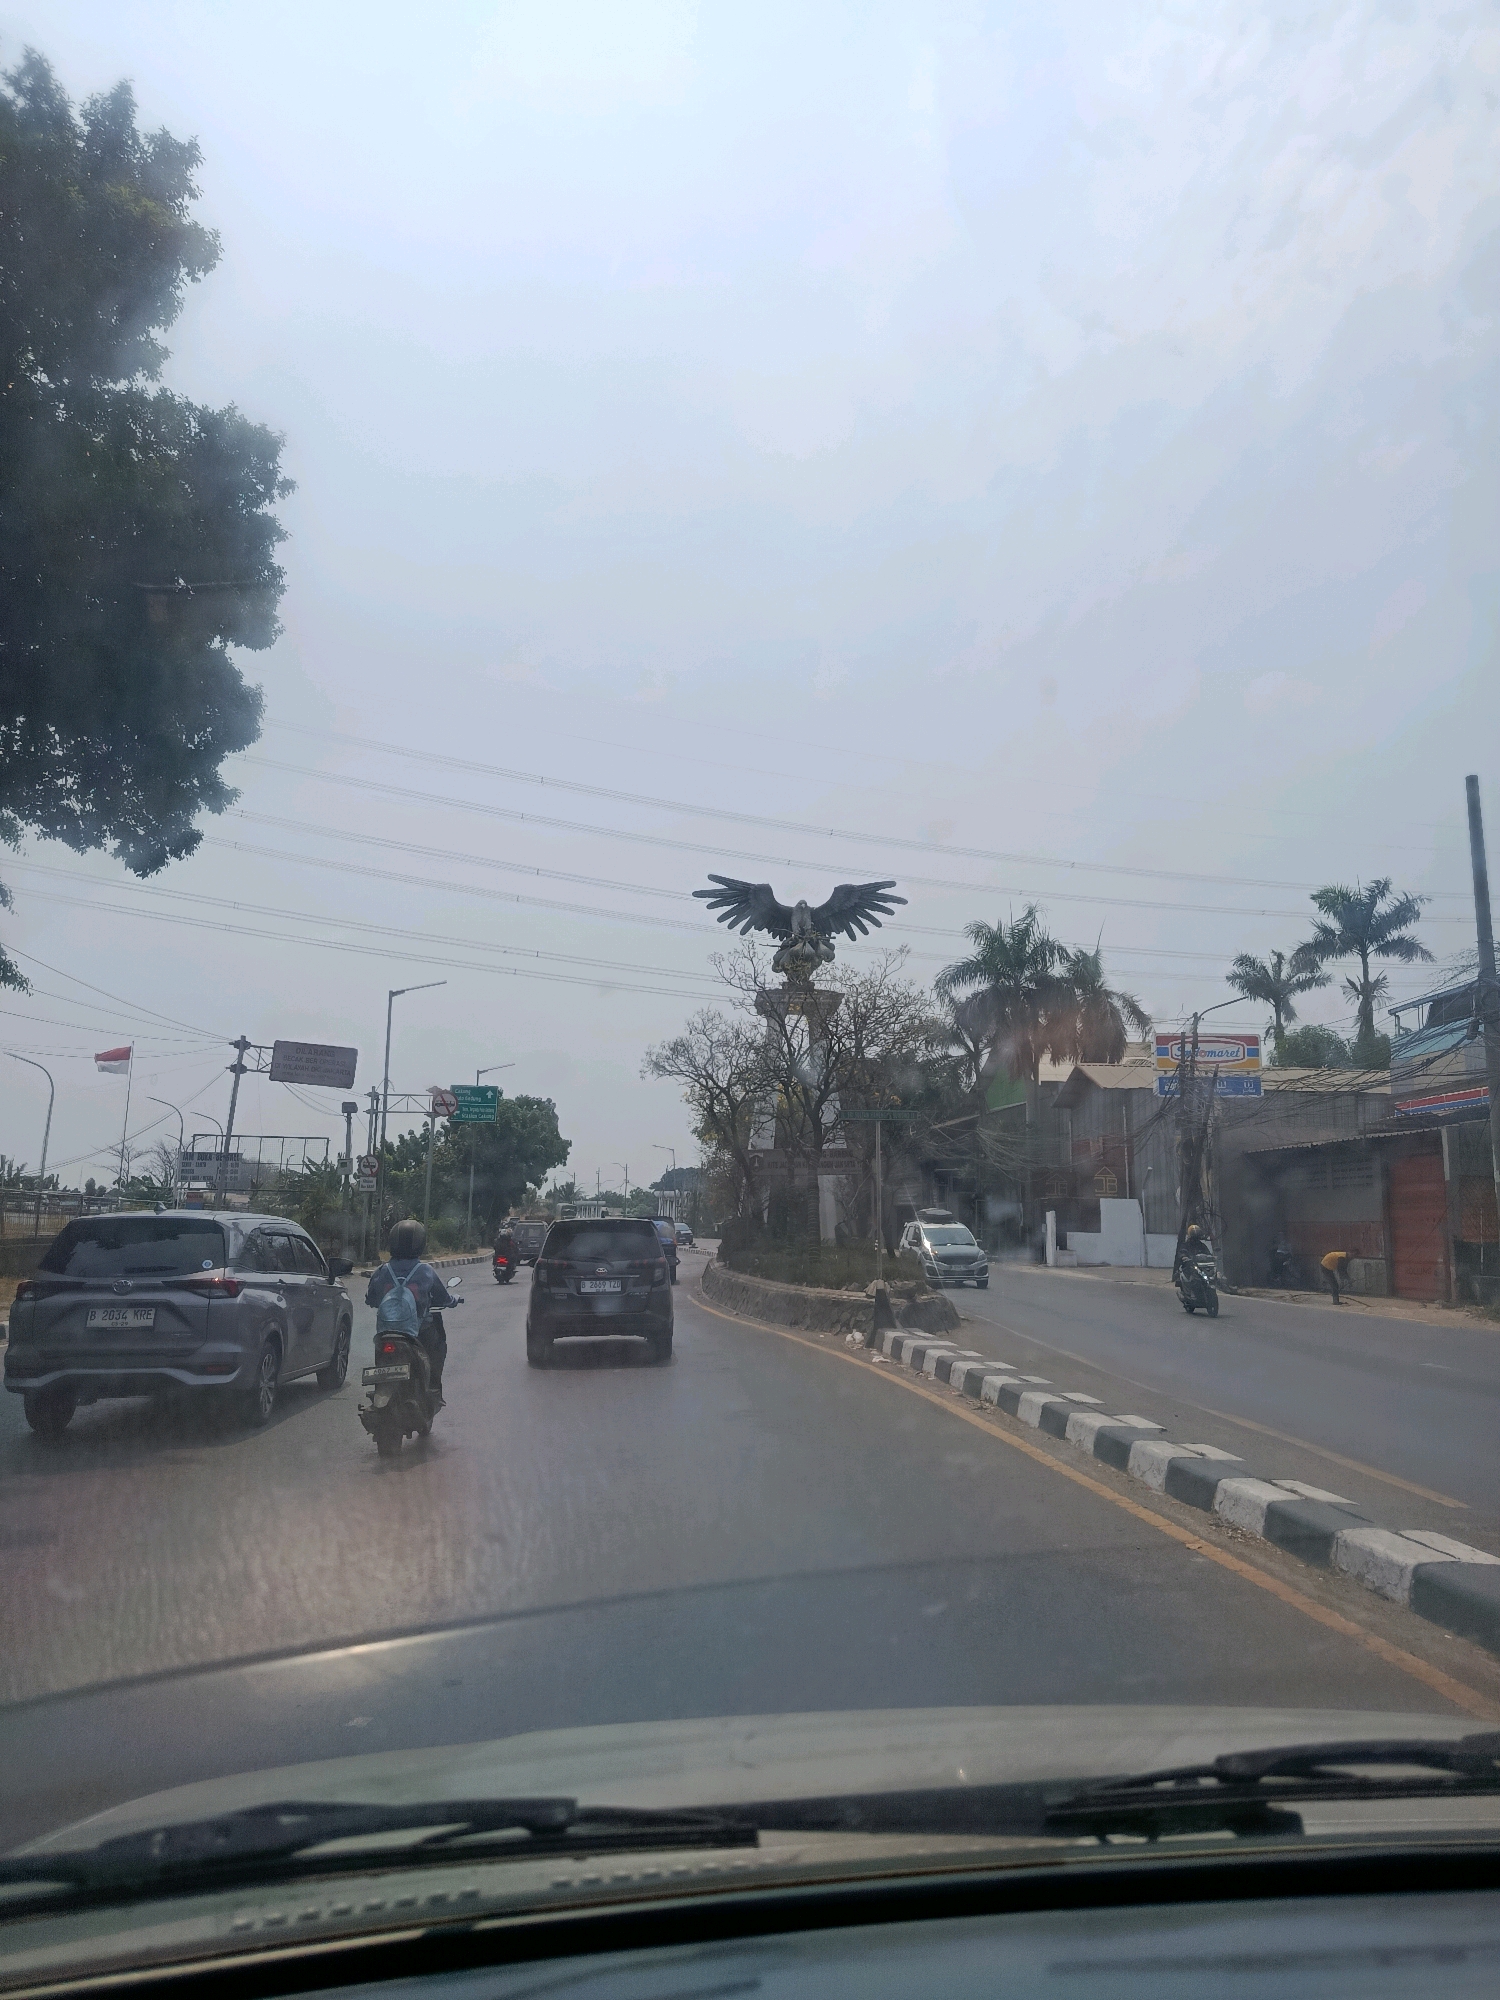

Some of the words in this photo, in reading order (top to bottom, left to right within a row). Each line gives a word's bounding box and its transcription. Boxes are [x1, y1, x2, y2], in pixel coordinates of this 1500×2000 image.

[296, 1048, 336, 1058] DILARANG
[1174, 1046, 1241, 1058] Indomaret
[283, 1064, 310, 1072] WILAYAH
[90, 1311, 96, 1321] B
[102, 1309, 128, 1321] 2034
[133, 1309, 153, 1320] KRE
